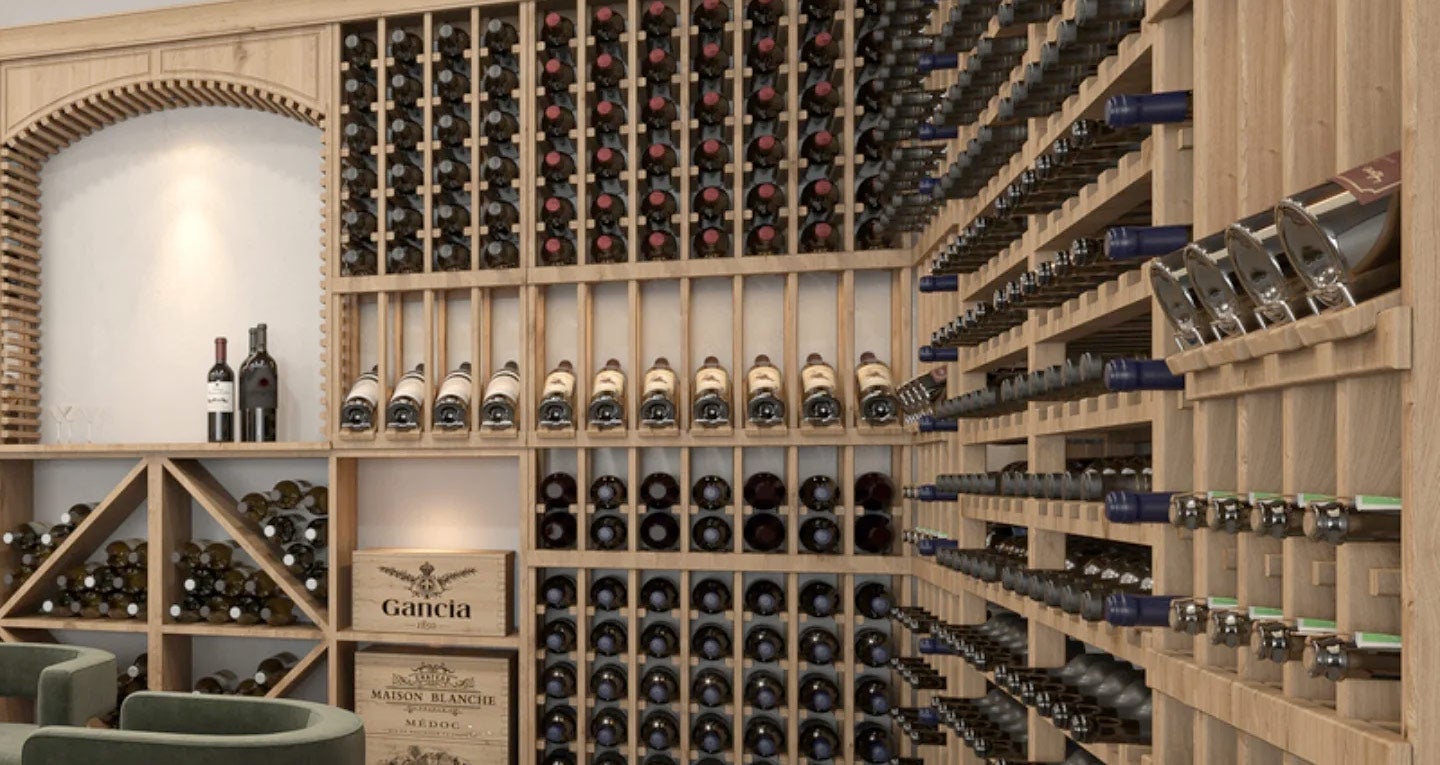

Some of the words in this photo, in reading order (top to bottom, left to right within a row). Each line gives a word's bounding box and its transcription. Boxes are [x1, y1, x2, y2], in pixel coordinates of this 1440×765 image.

[381, 598, 472, 619] Gancia
[370, 688, 424, 702] MAISON
[430, 692, 496, 706] BLANCHE
[405, 718, 461, 730] MÉDOC
